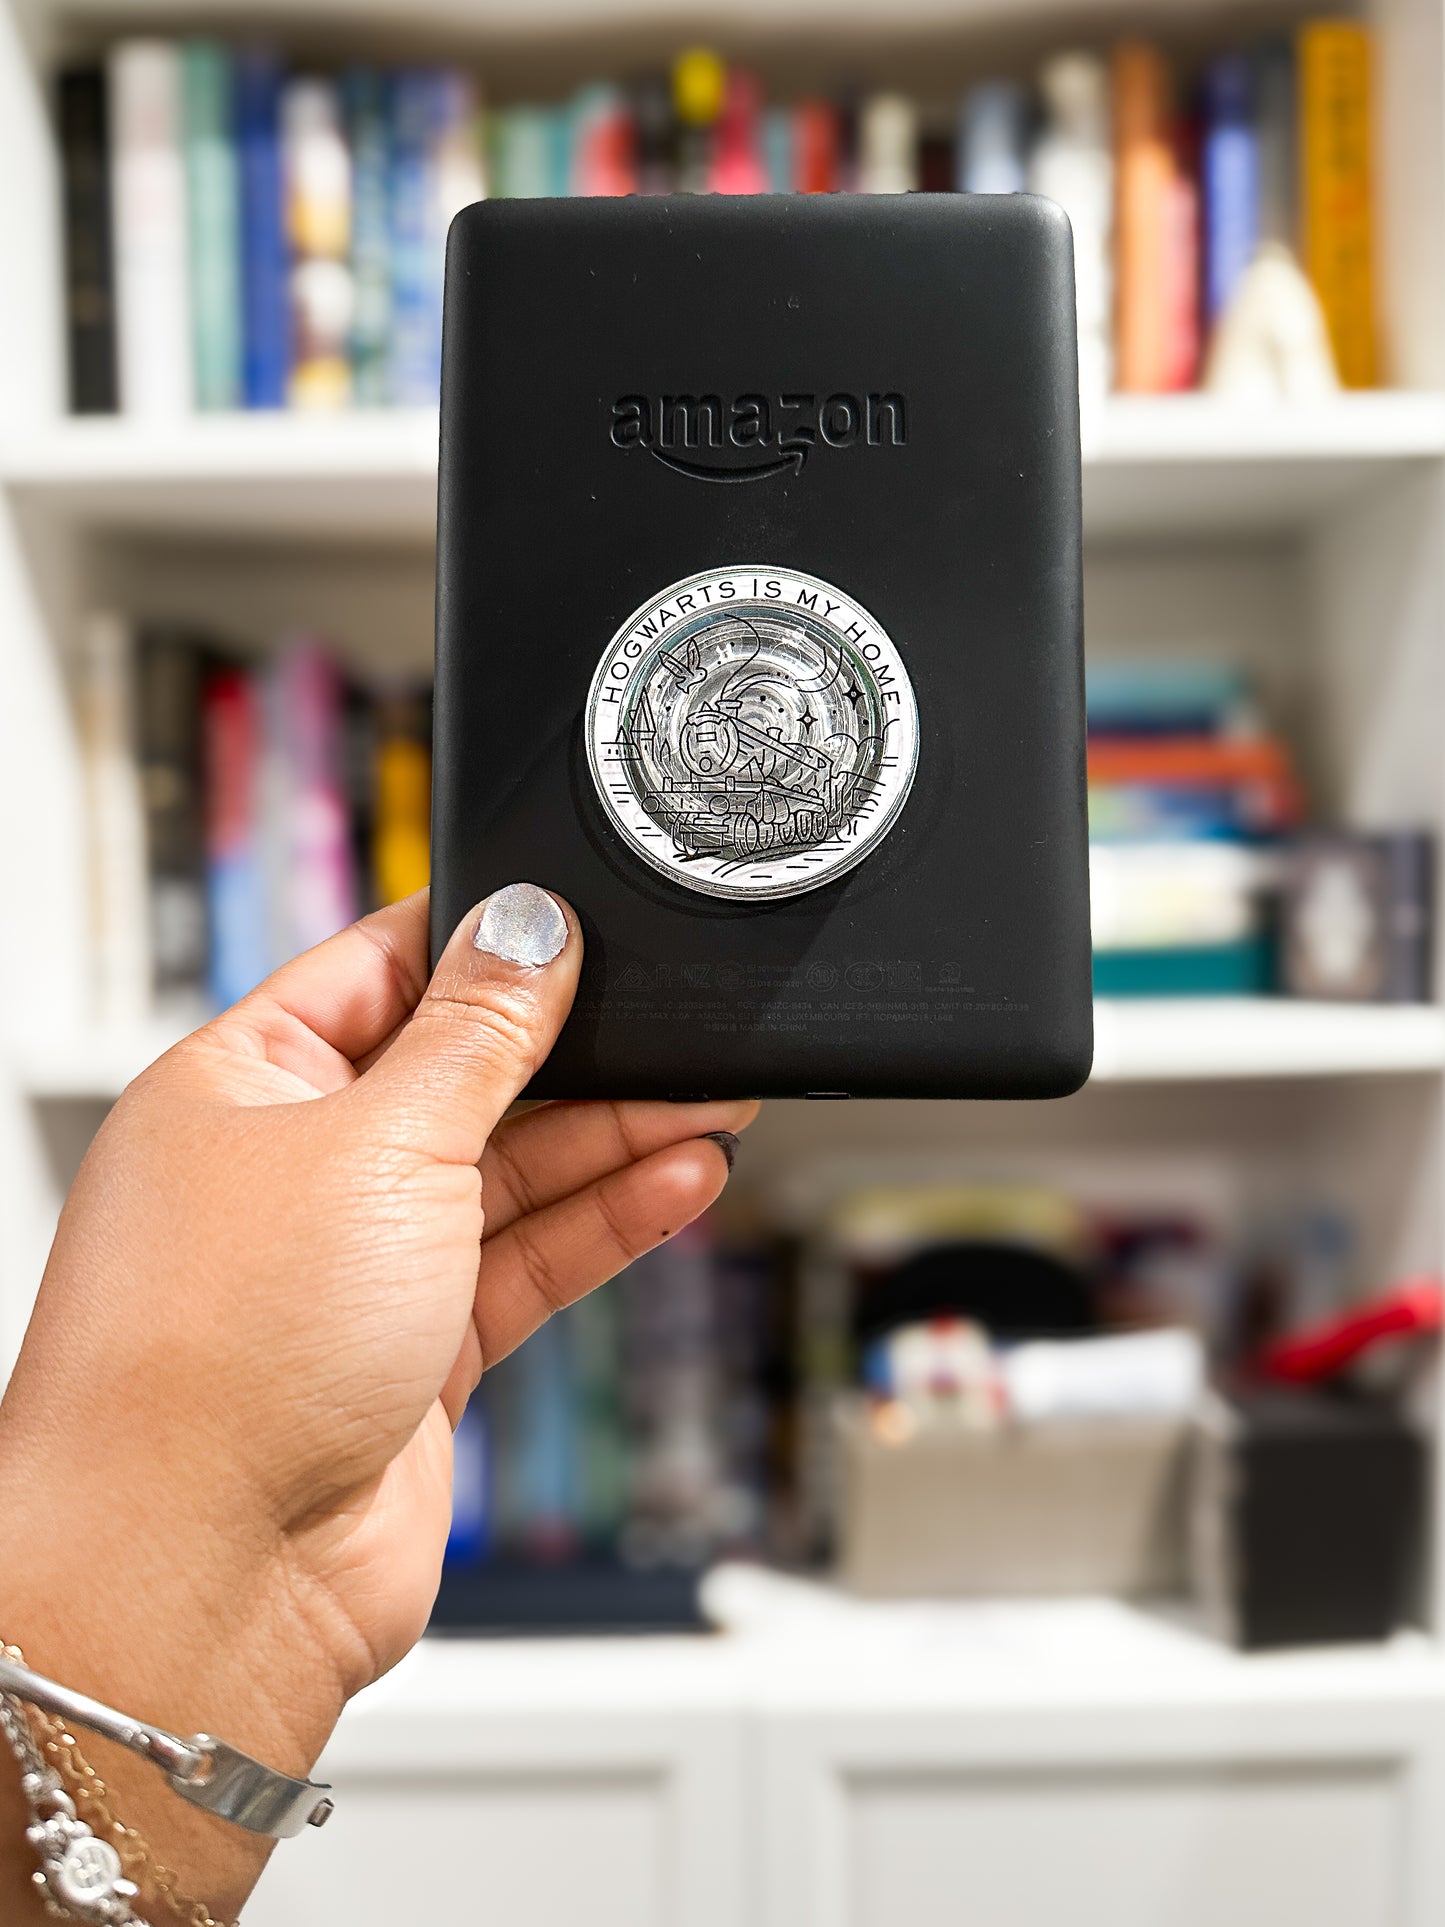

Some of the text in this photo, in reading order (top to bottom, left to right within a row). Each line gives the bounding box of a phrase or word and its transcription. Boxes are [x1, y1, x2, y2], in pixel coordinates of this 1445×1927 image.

[608, 393, 908, 449] amazon
[601, 578, 901, 705] HOGWARTS IS MY HOME
